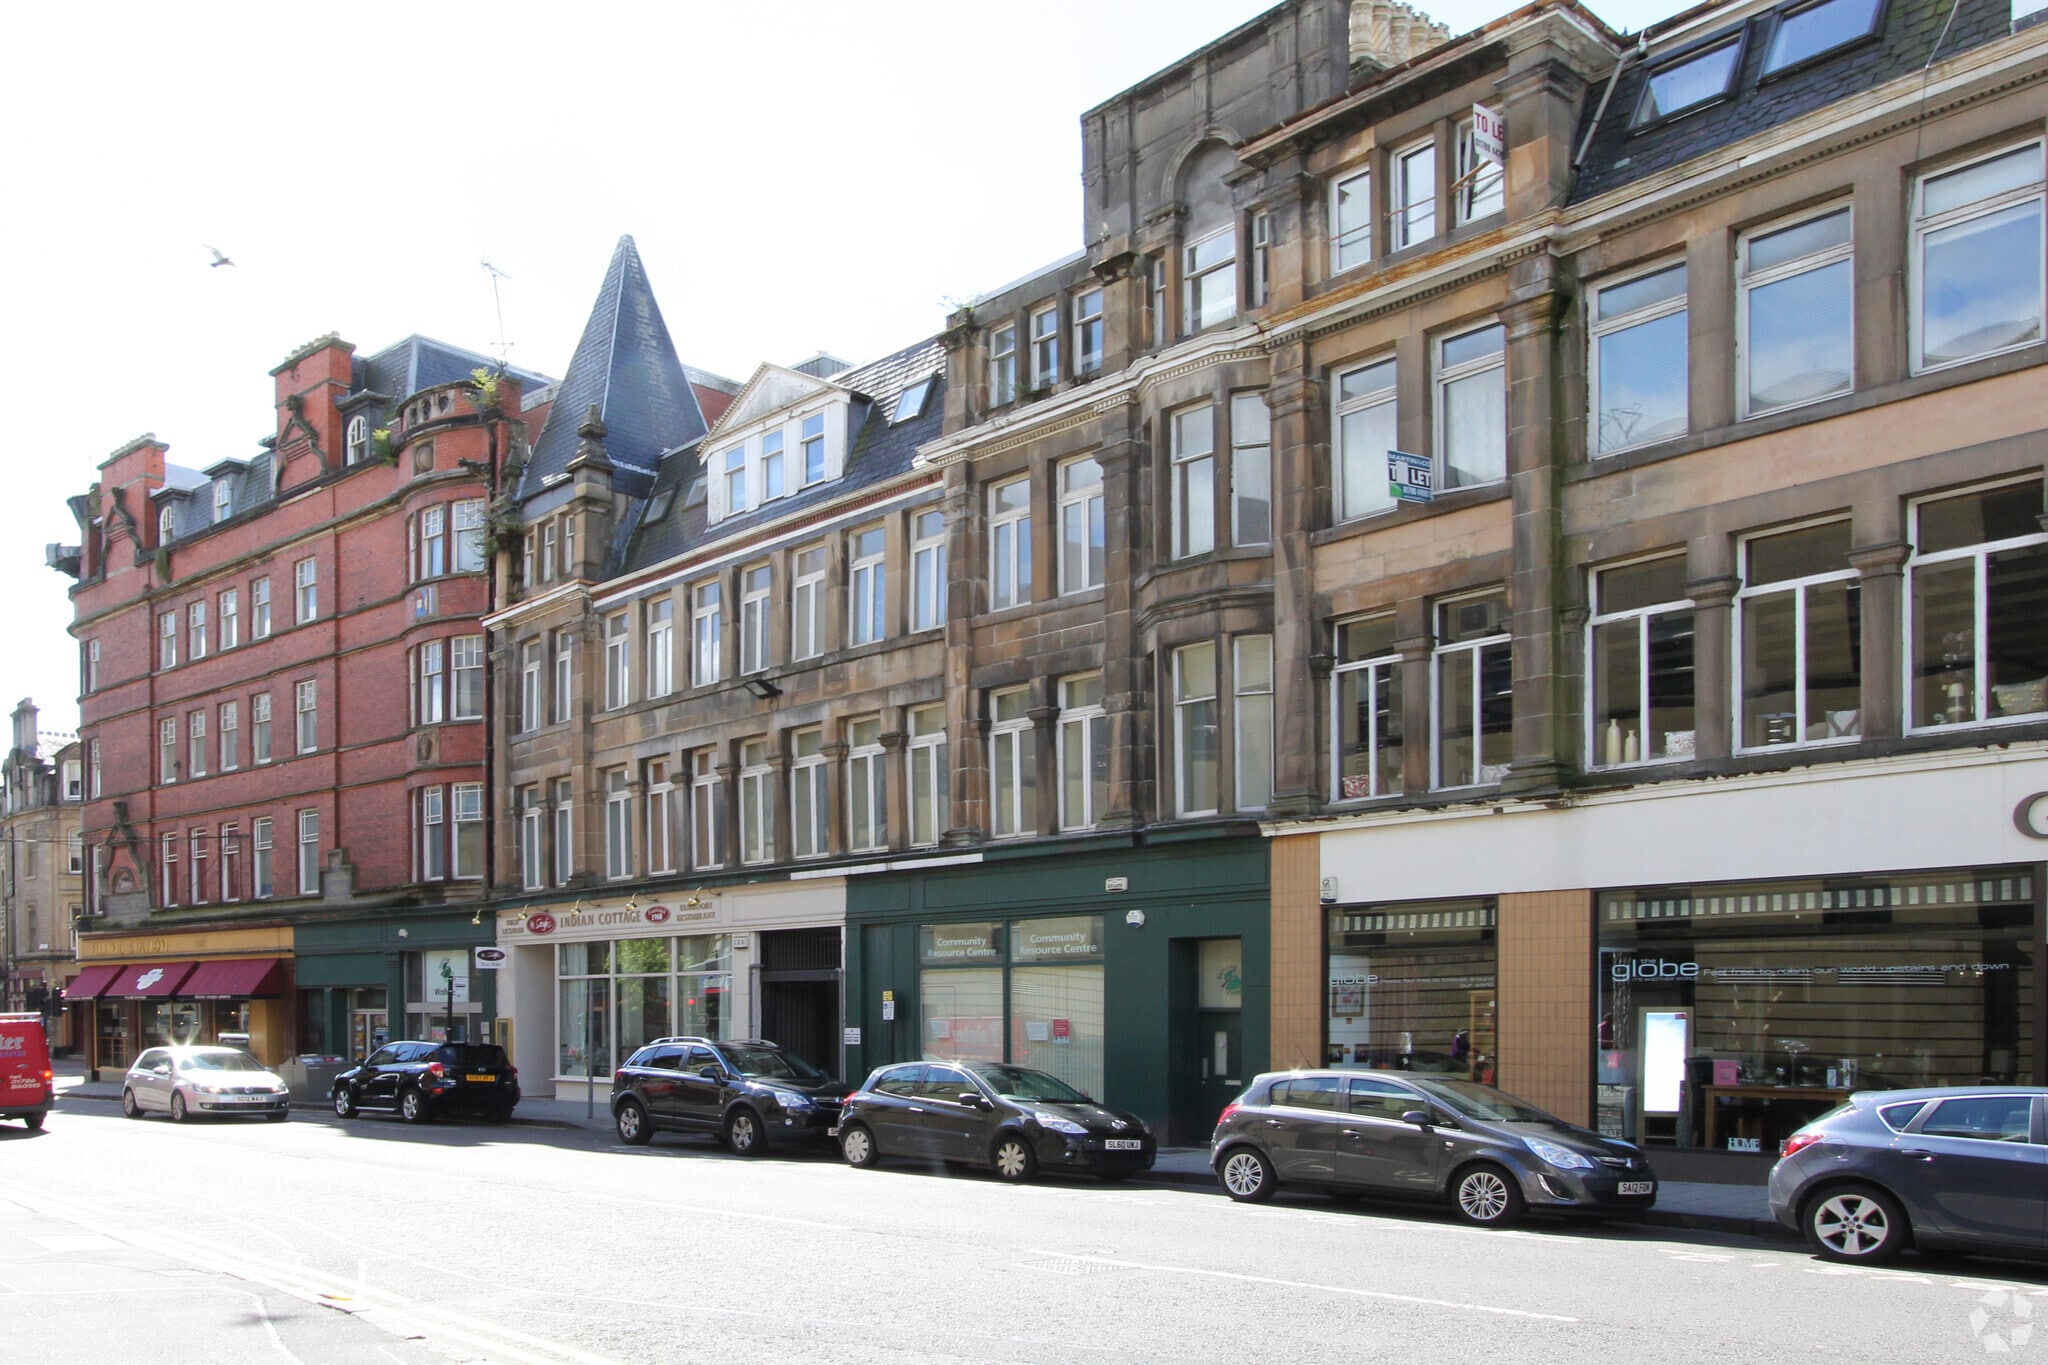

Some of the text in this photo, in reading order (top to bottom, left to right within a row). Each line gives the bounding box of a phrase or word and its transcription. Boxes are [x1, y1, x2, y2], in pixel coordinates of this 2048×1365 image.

[1475, 112, 1504, 142] TO LE
[1411, 469, 1430, 486] LET
[560, 910, 642, 928] INDIAN COTTAGE
[936, 936, 987, 947] Community
[1030, 931, 1086, 943] Community
[927, 947, 997, 958] Resource Centre
[1020, 944, 1098, 955] Resource Centre
[1611, 958, 1700, 982] globe
[1703, 968, 1728, 976] Feel
[1840, 965, 1876, 973] world
[1880, 964, 1936, 974] upstairs
[1971, 962, 2010, 971] down
[1330, 973, 1379, 986] globe
[1469, 975, 1495, 983] around
[1727, 1137, 1761, 1152] HOME
